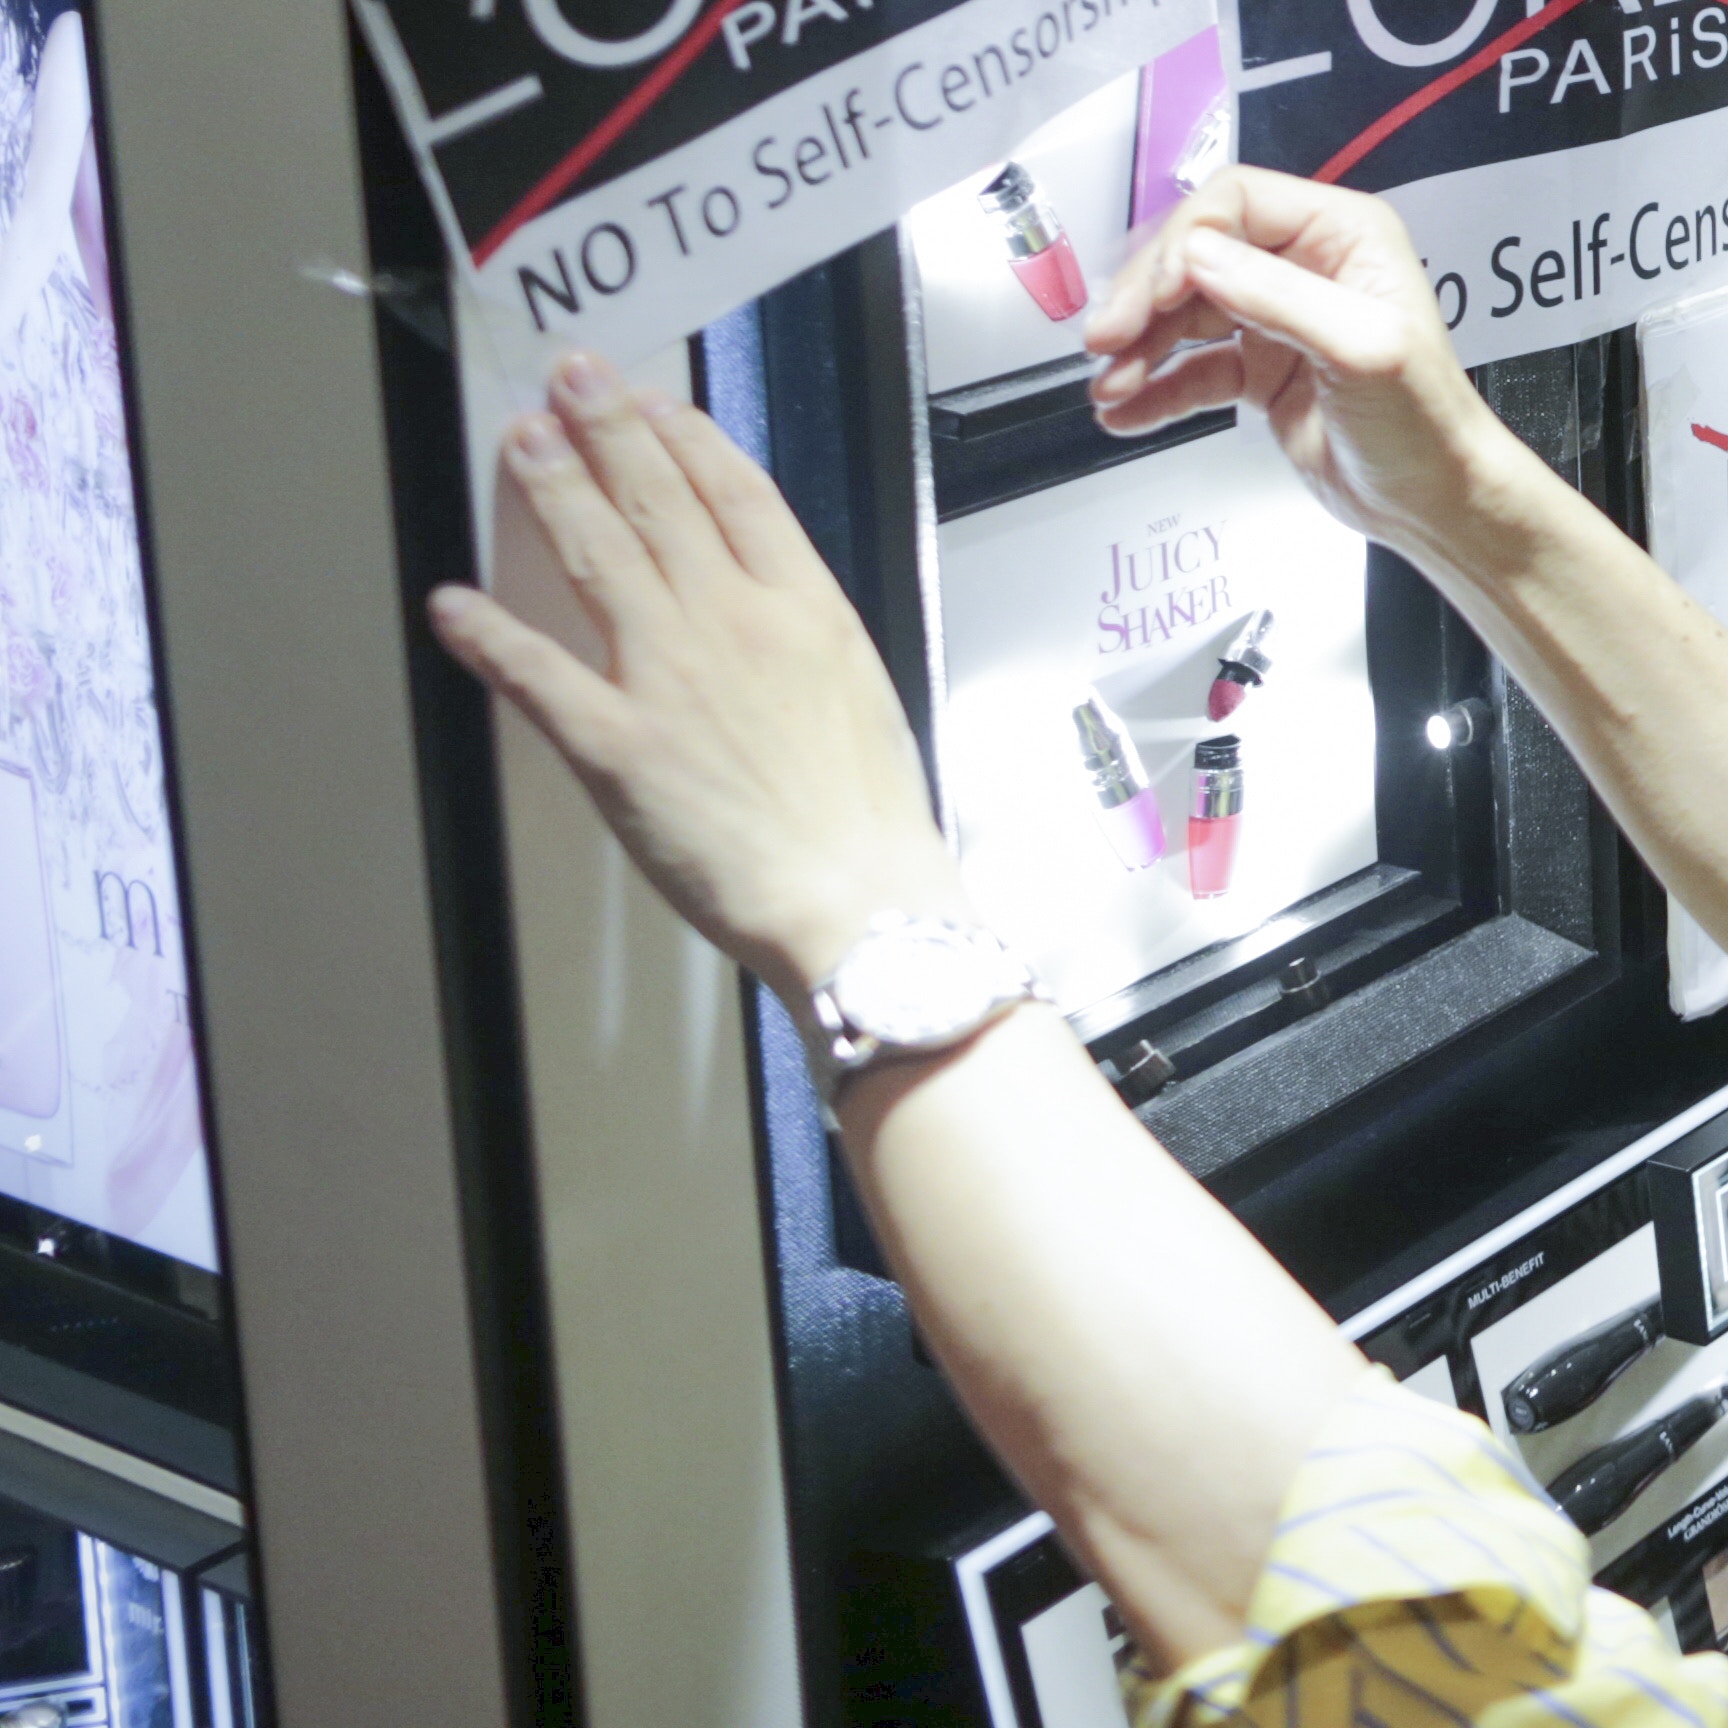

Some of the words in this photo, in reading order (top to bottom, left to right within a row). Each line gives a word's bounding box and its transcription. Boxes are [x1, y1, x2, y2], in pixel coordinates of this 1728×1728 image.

[517, 222, 637, 334] NO
[648, 182, 742, 259] To
[1101, 519, 1228, 604] JUICY
[1147, 513, 1181, 536] NEW
[1098, 575, 1232, 654] SHAKER
[1467, 1250, 1545, 1310] MULTI-BENEFIT
